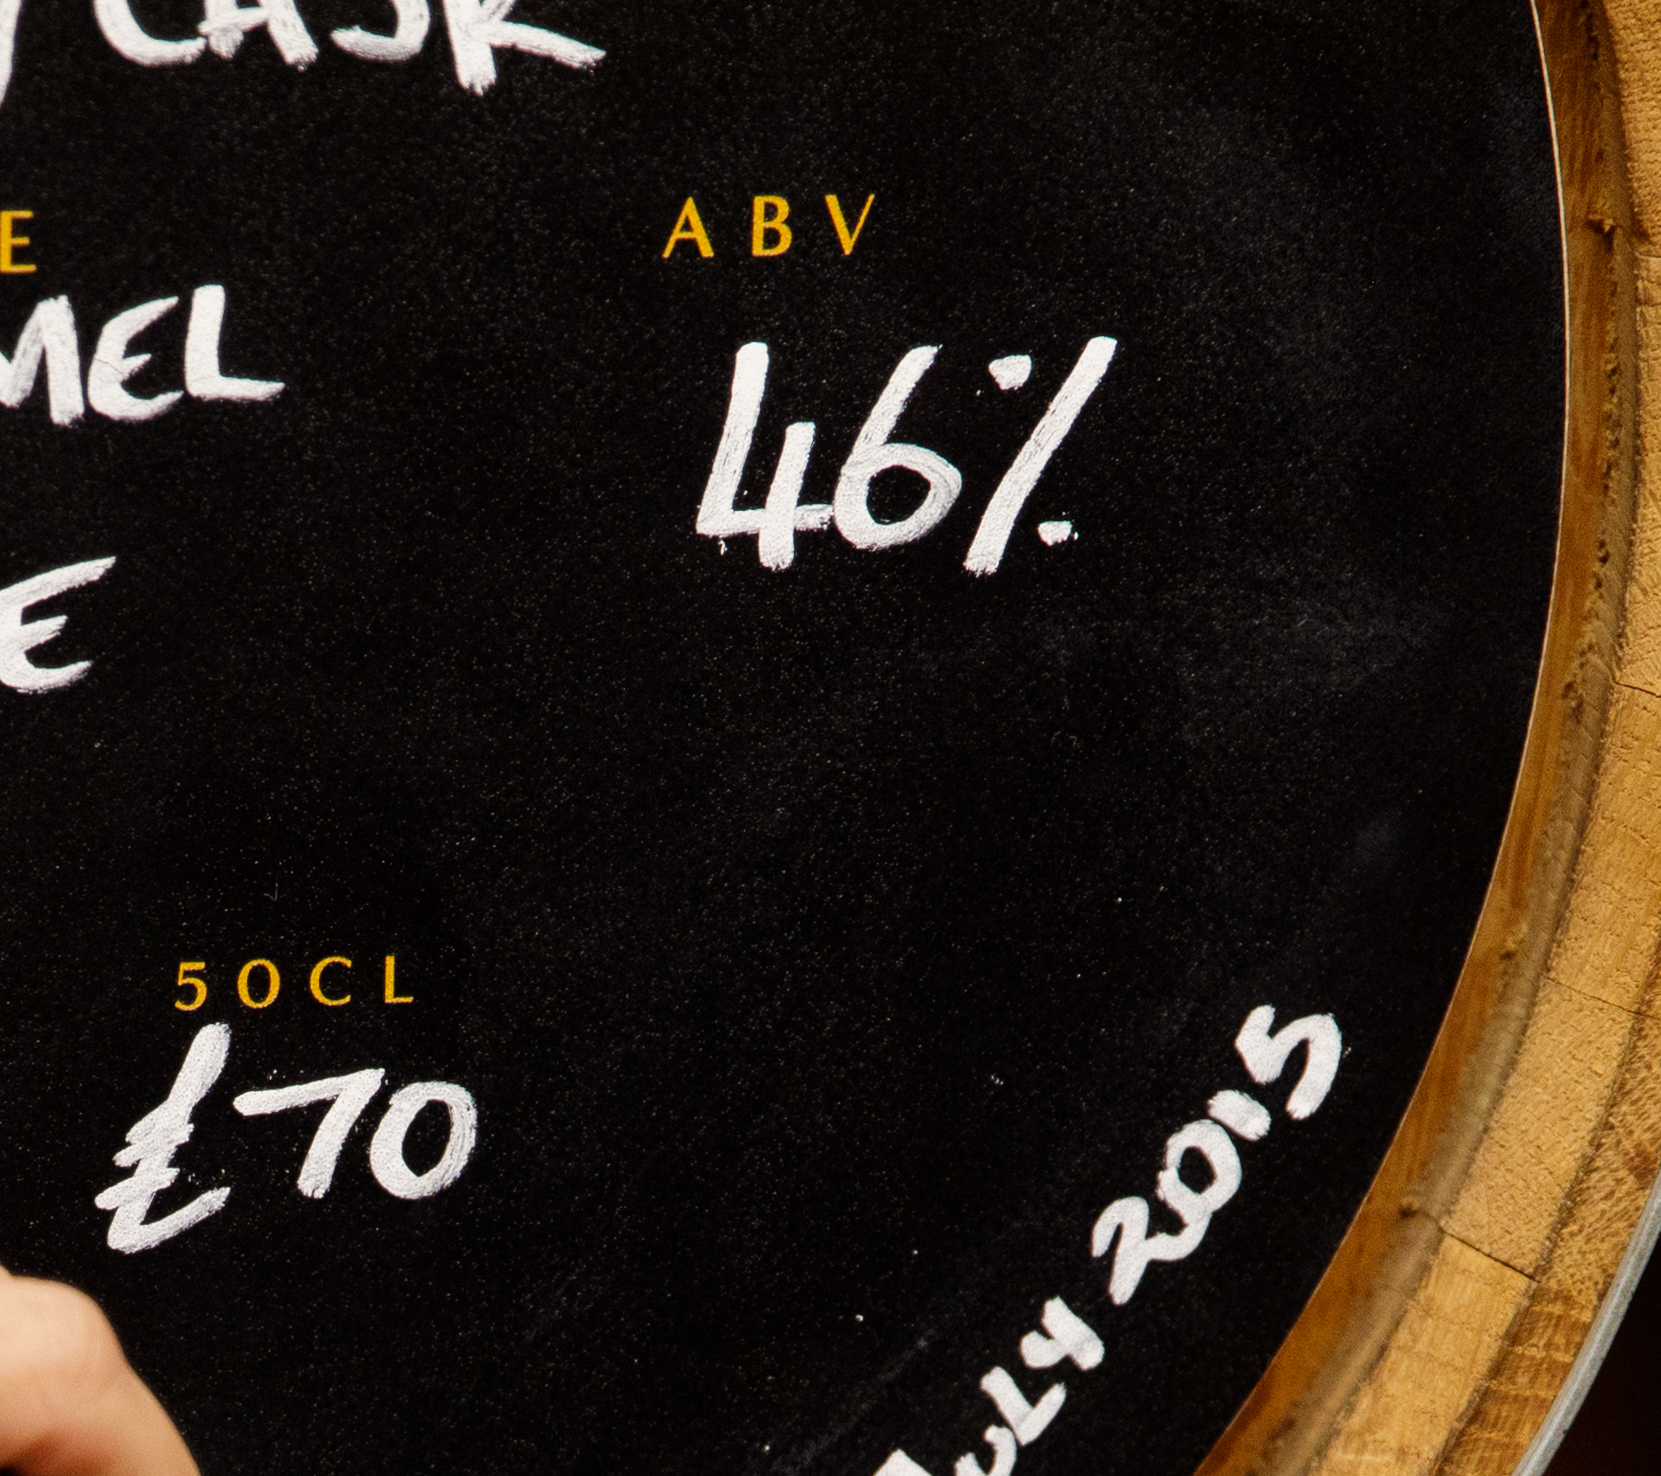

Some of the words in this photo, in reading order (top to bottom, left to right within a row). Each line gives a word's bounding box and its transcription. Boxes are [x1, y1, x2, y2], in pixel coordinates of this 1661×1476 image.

[662, 194, 875, 259] ABV
[696, 336, 1118, 577] 46%
[174, 955, 414, 1012] 50CL
[95, 1022, 478, 1254] £70
[1092, 1005, 1342, 1305] 2015
